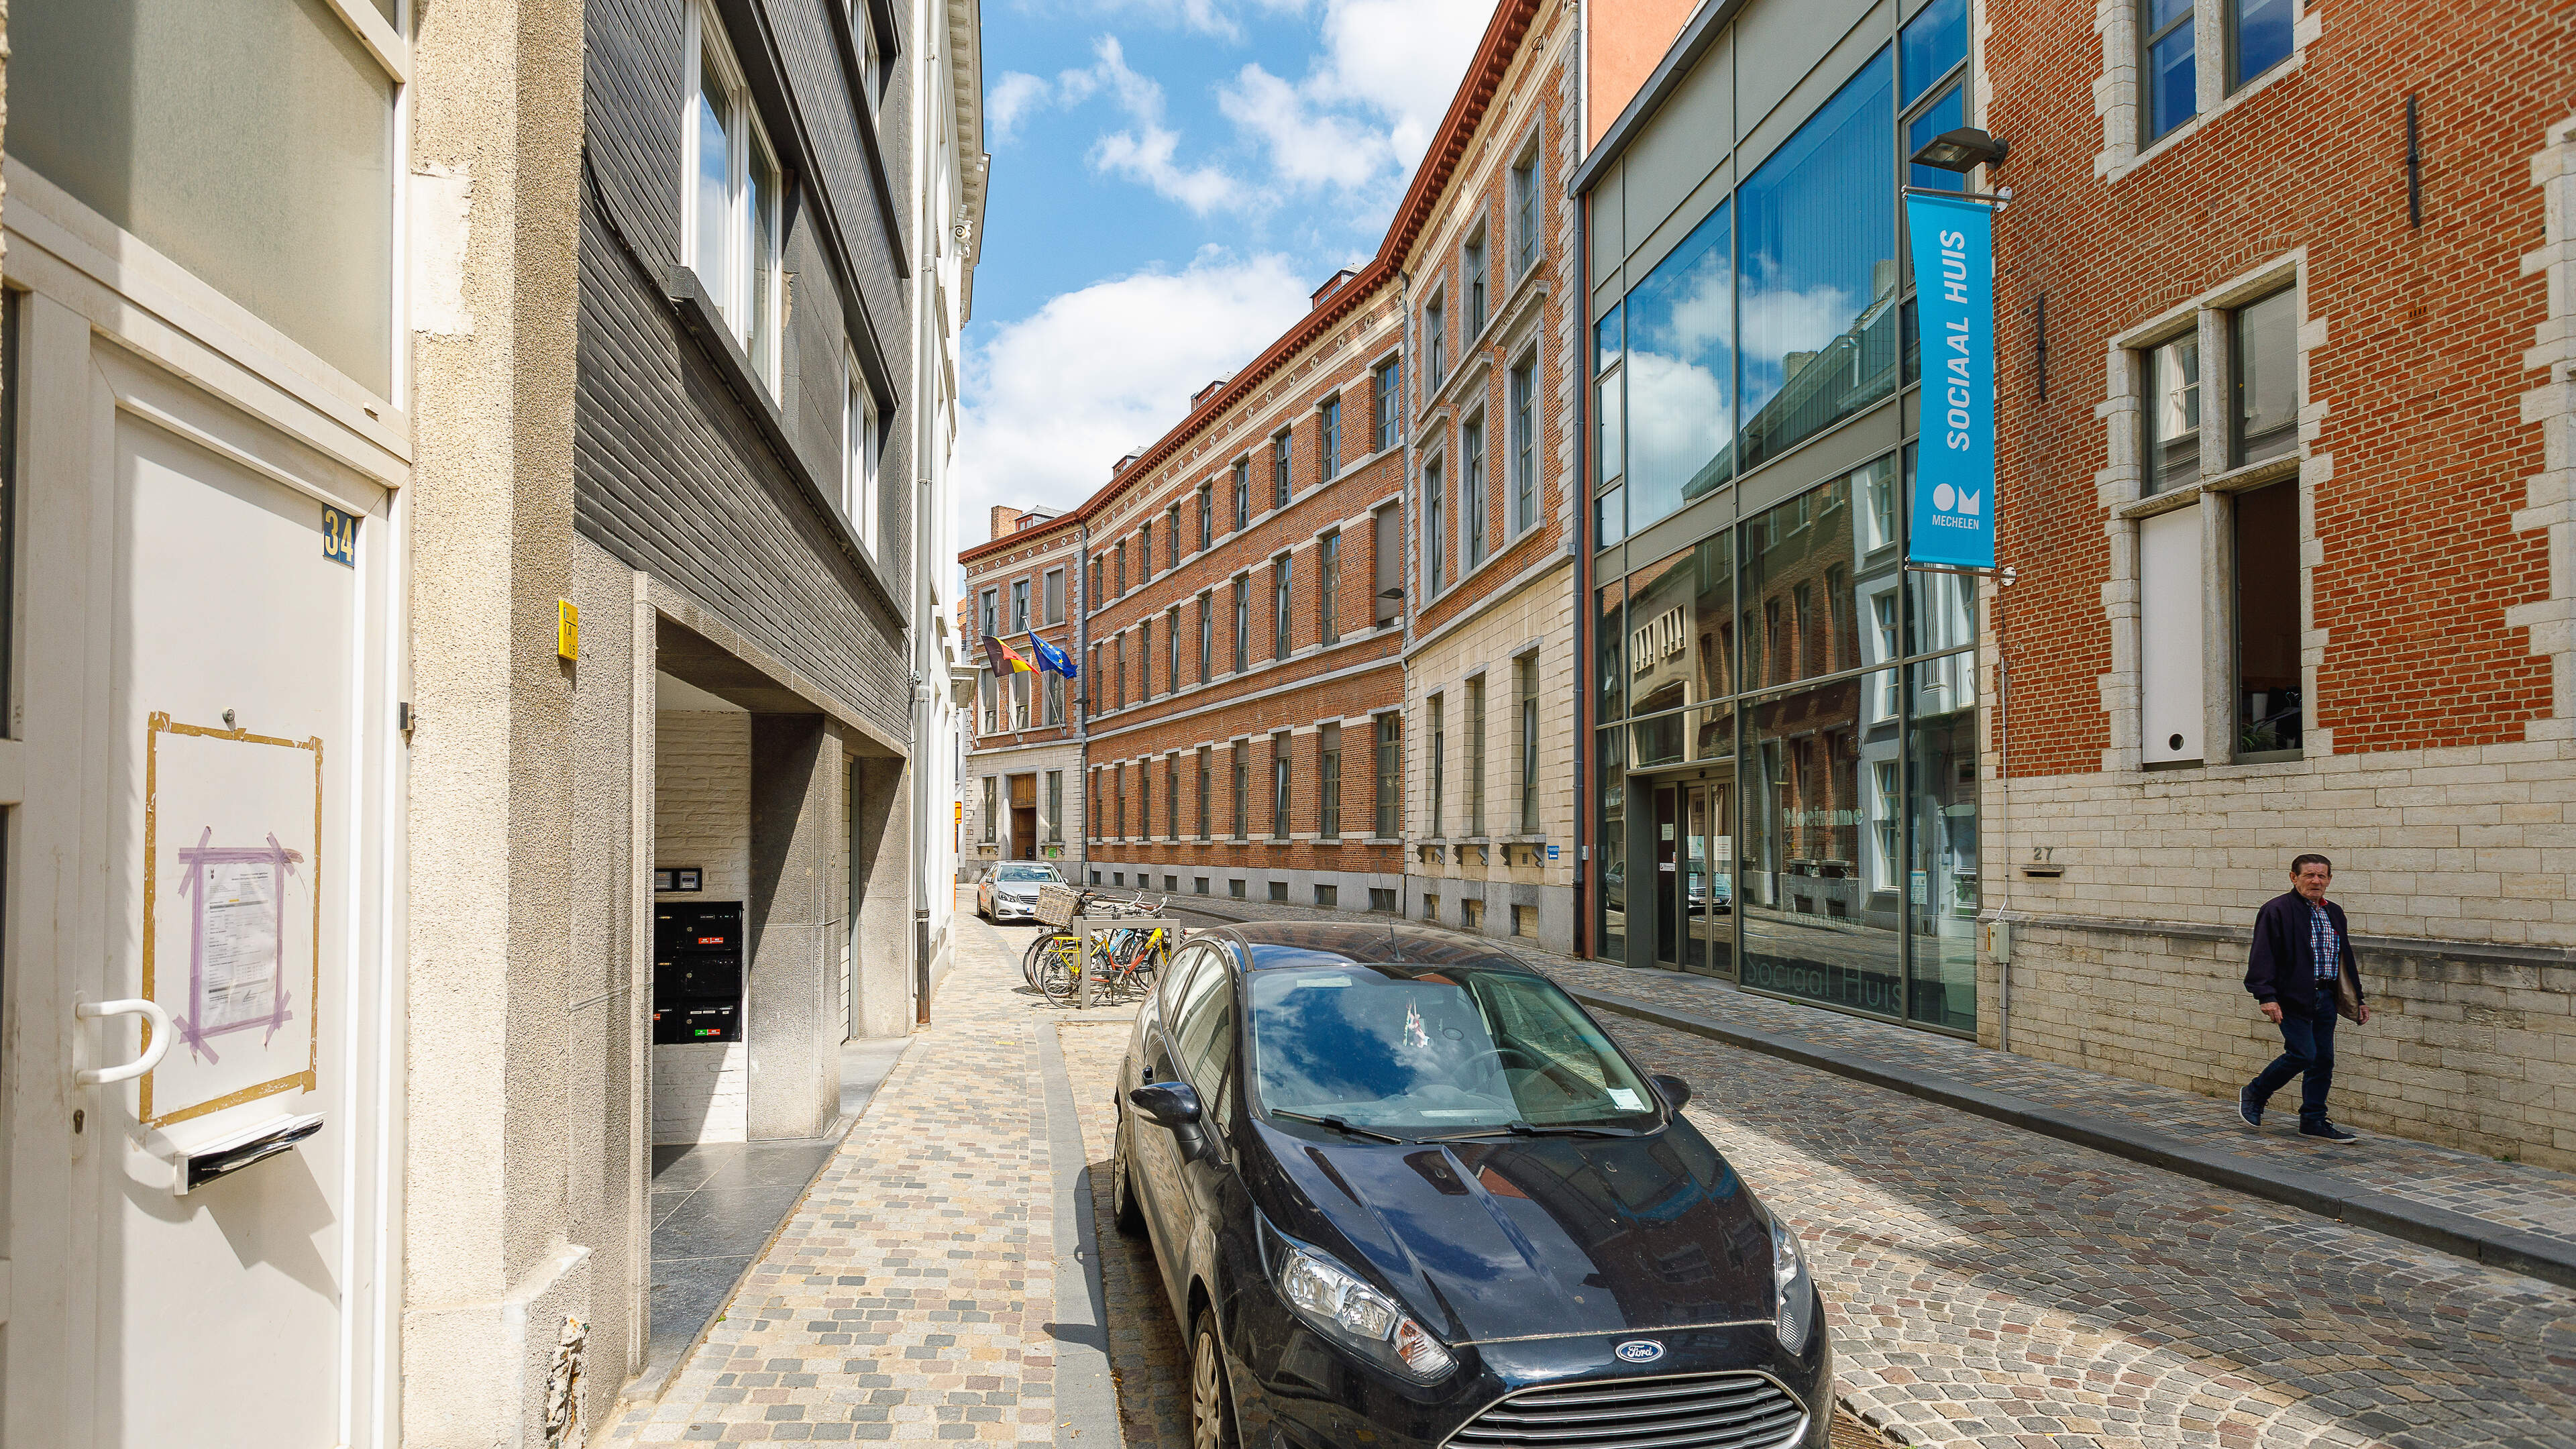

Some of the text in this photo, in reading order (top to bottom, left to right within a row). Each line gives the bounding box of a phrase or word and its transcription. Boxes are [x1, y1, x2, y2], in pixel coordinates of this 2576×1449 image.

[1940, 230, 1970, 451] SOCIAAL HUIS
[1932, 515, 1979, 530] MECHELEN
[325, 510, 353, 562] 34
[1783, 806, 1864, 827] Moeizame
[2034, 847, 2053, 859] 27
[1745, 952, 1902, 1012] Sociaal Huis
[1627, 1345, 1653, 1357] Ford
